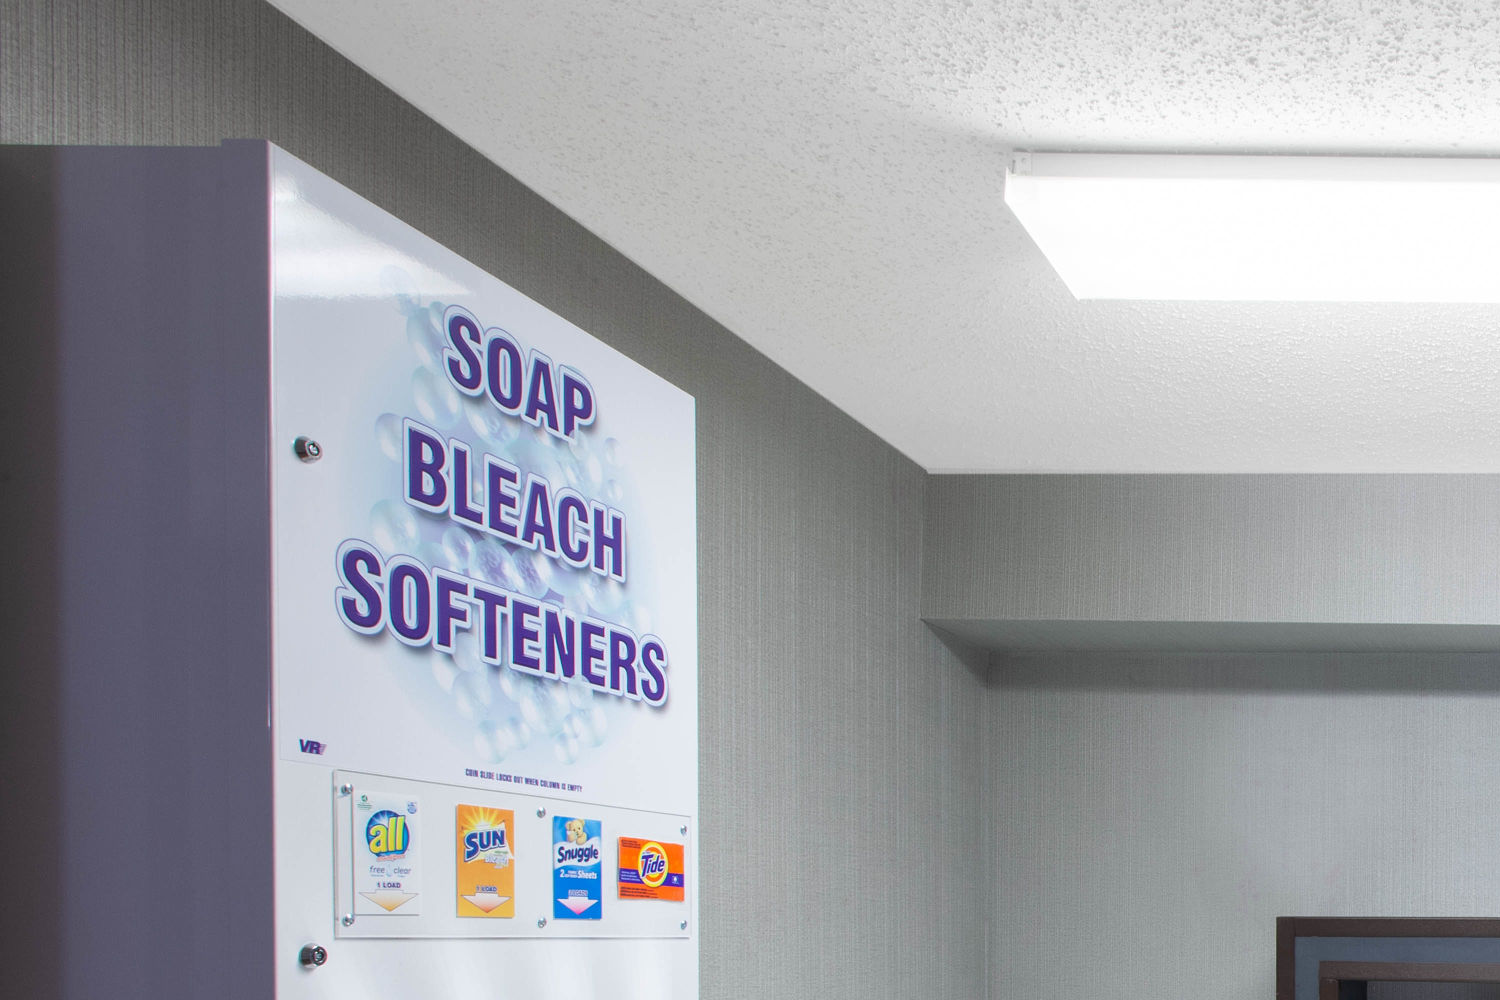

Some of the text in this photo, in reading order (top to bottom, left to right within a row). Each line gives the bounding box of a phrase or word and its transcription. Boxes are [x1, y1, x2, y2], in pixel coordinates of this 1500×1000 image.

[445, 310, 596, 441] SOAP
[404, 422, 627, 580] BLEACH
[338, 545, 668, 704] SOFTENERS
[465, 768, 479, 777] COIN
[480, 770, 495, 780] SLIDE
[496, 773, 512, 783] LOCKS
[513, 775, 523, 785] OUT
[524, 777, 539, 787] WHEN
[540, 779, 560, 789] COLUMN
[567, 784, 583, 792] EMPTY
[368, 815, 406, 854] all
[463, 828, 506, 861] SUN
[557, 844, 599, 863] Snuggle
[641, 853, 666, 878] Tide
[369, 865, 411, 875] free clear
[560, 869, 565, 878] 2
[577, 869, 597, 880] Sheets
